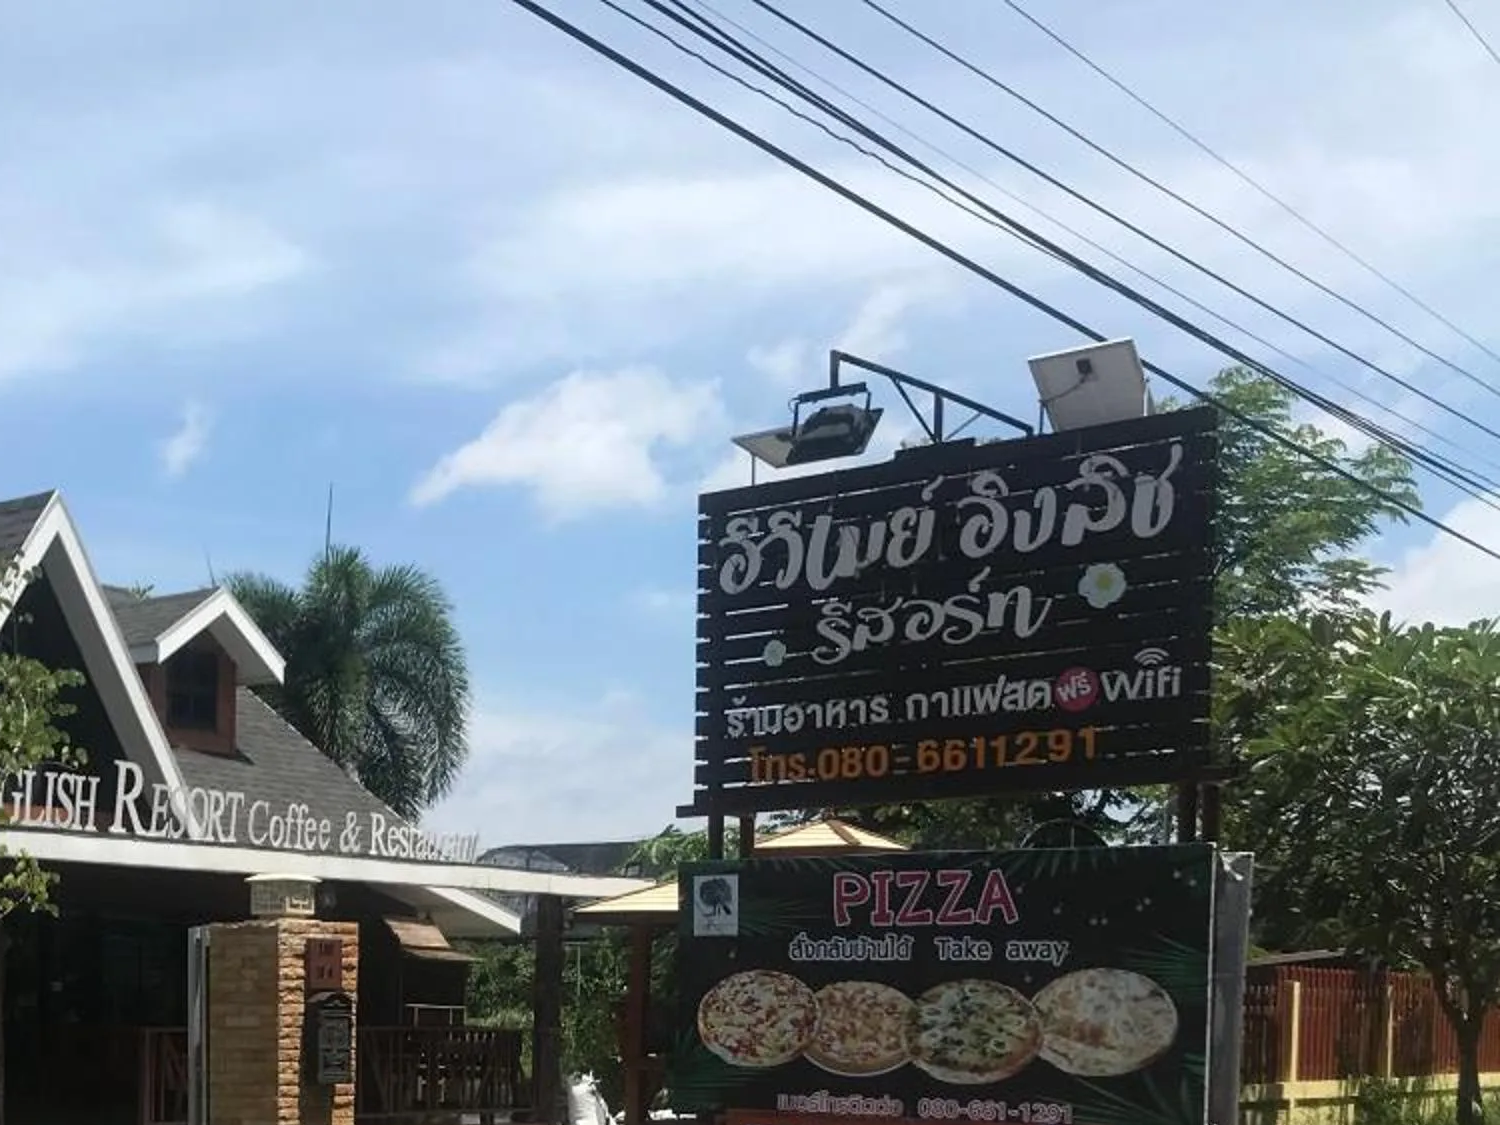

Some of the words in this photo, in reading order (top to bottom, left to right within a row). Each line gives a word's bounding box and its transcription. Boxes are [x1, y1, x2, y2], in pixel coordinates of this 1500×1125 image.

[811, 567, 1052, 665] รีสอร์ท
[726, 695, 889, 738] ร้านอาหาร
[905, 676, 1052, 722] กาแฟสด
[249, 800, 331, 850] Coffee
[340, 811, 362, 853] &
[833, 870, 1019, 926] PIZZA
[934, 936, 992, 961] Take
[1005, 940, 1069, 966] away
